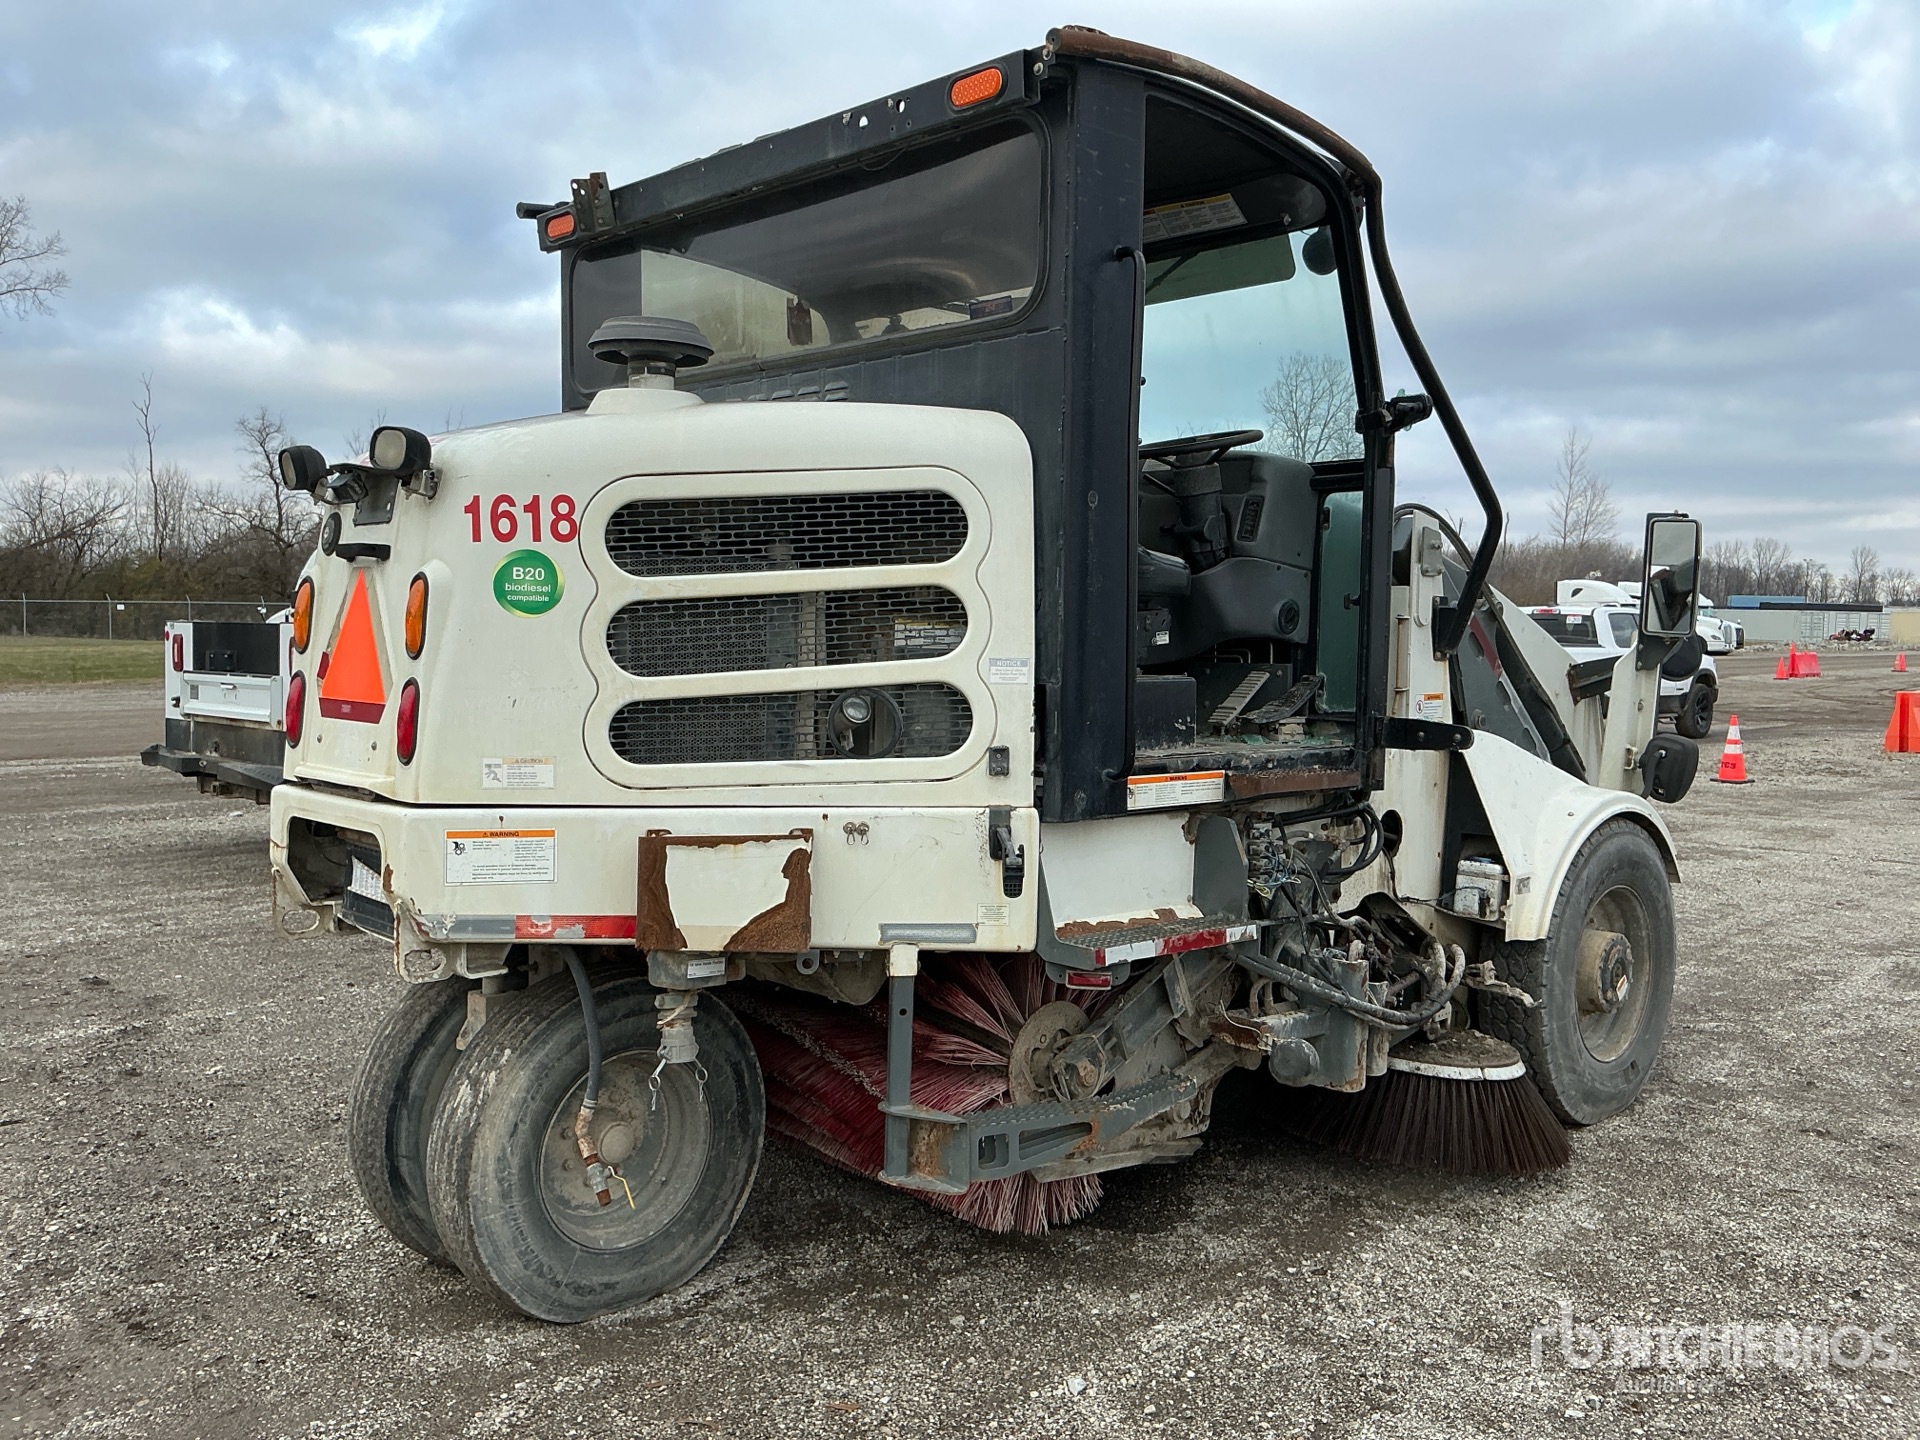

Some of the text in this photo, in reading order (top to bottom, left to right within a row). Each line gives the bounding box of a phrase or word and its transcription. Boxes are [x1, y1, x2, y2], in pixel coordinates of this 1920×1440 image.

[463, 493, 578, 543] 1618
[511, 566, 545, 581] B20
[504, 582, 551, 593] biodiesel
[506, 594, 550, 603] compatible
